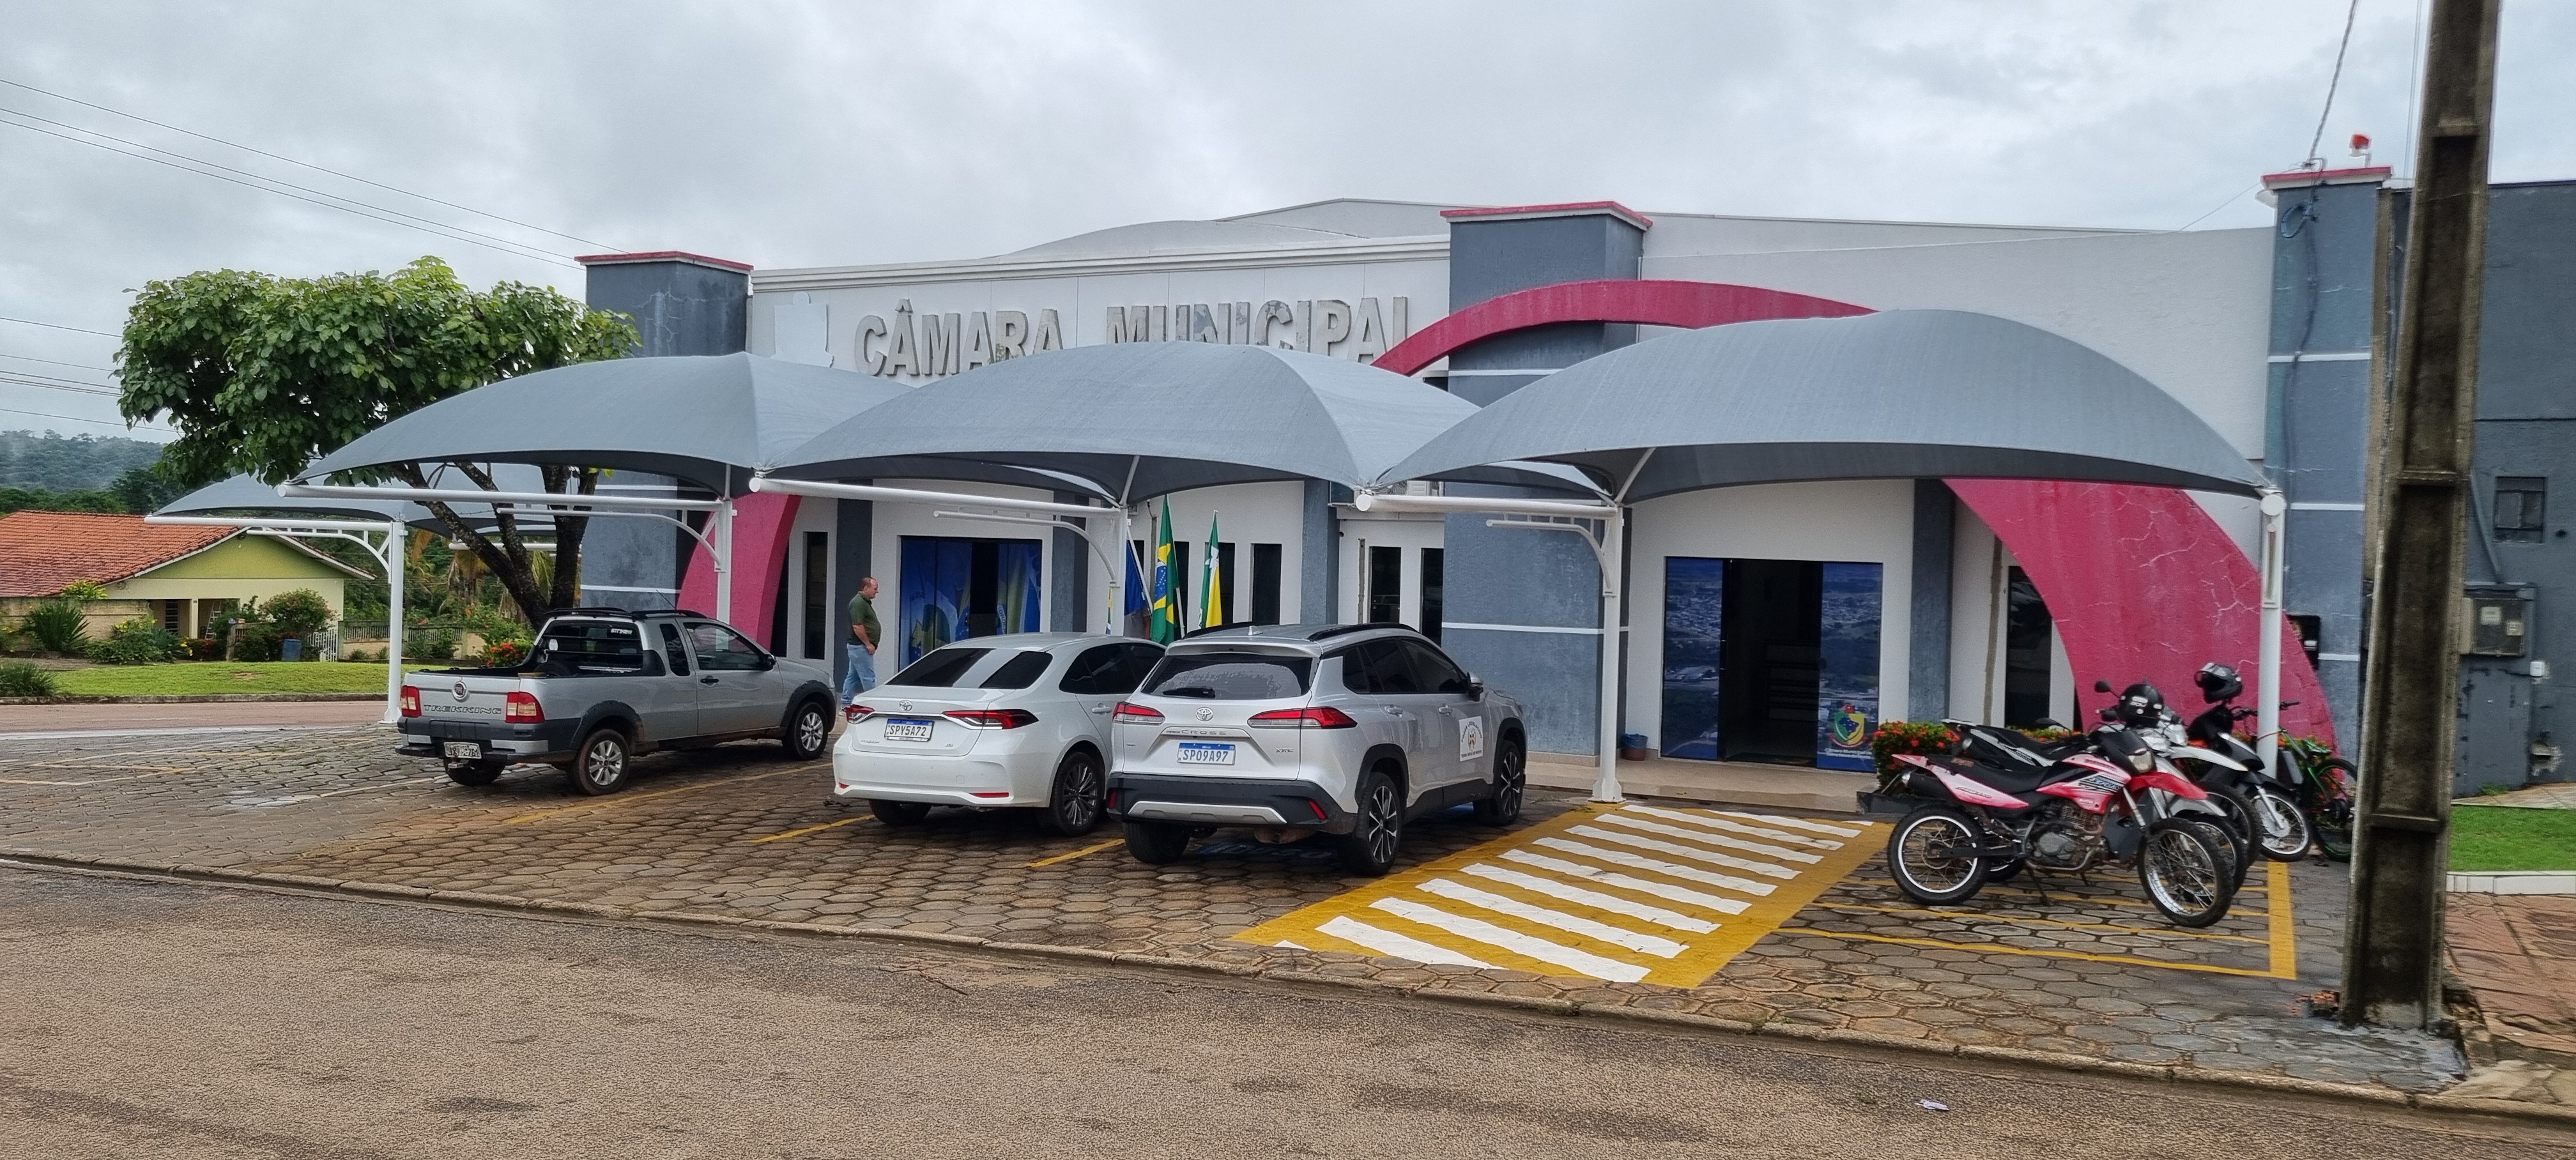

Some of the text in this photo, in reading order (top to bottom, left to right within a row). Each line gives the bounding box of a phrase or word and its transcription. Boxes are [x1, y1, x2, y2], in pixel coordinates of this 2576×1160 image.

[854, 299, 1064, 376] CÂMARA
[423, 704, 502, 715] TREKKING
[889, 725, 927, 736] SPY5A72
